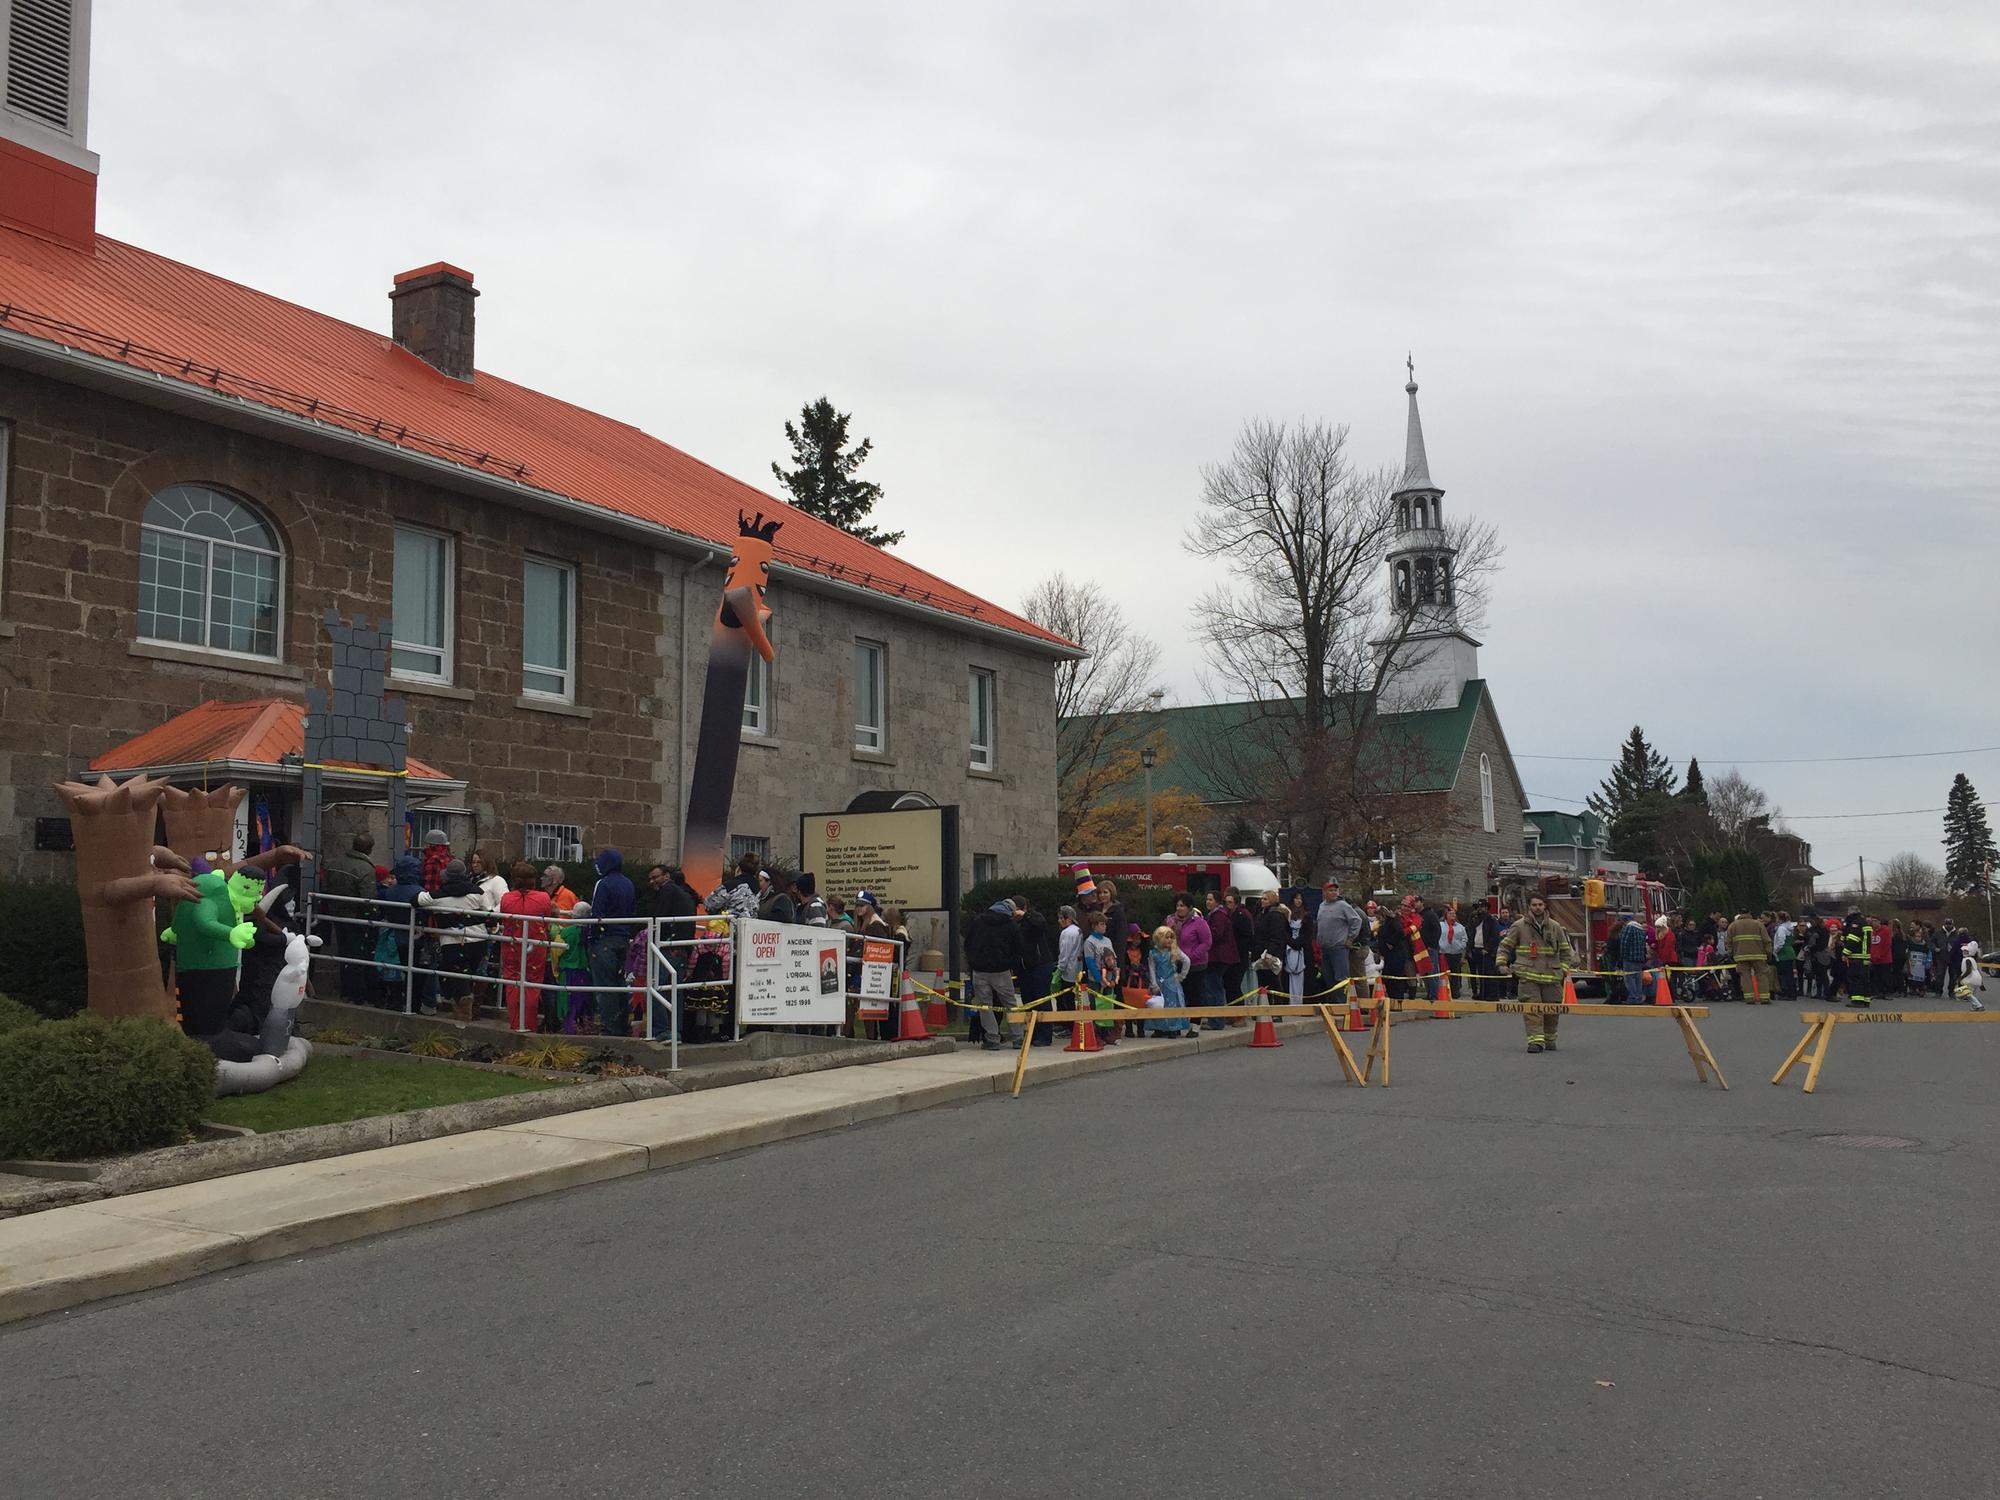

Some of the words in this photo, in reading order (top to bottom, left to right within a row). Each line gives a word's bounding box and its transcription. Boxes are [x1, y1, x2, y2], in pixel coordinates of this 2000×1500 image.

[752, 933, 781, 945] OUVERT
[756, 946, 775, 958] OPEN
[1496, 1003, 1524, 1013] ROAD
[1530, 1005, 1569, 1014] CLOSED
[1857, 1012, 1903, 1023] CAUTION
